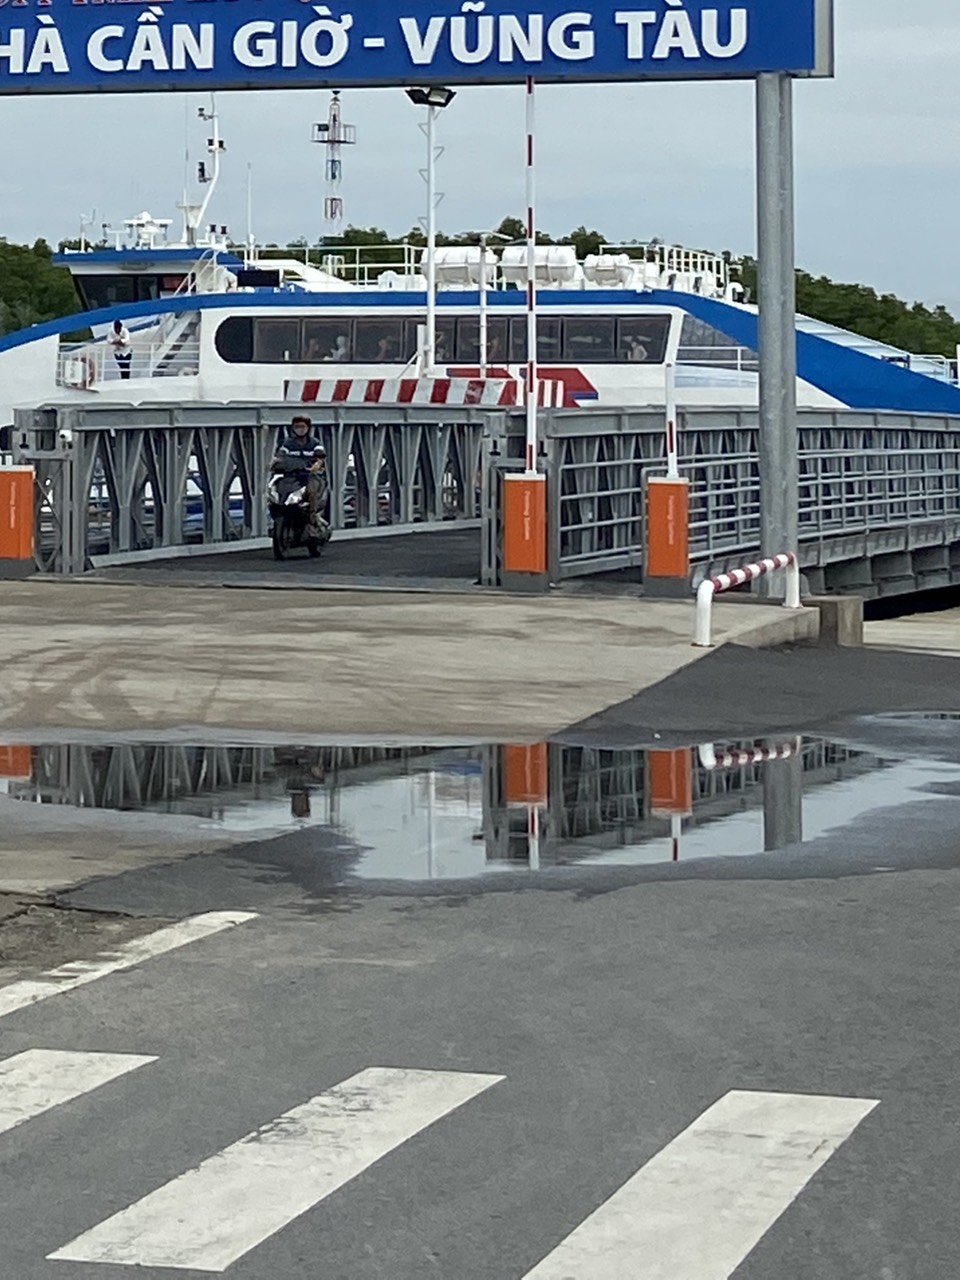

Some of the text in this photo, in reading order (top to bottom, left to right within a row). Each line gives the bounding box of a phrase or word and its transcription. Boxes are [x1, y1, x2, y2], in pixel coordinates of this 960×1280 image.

[87, 6, 214, 72] CẦN
[233, 5, 353, 67] GIỜ
[363, 37, 385, 47] -
[399, 1, 594, 64] VŨNG
